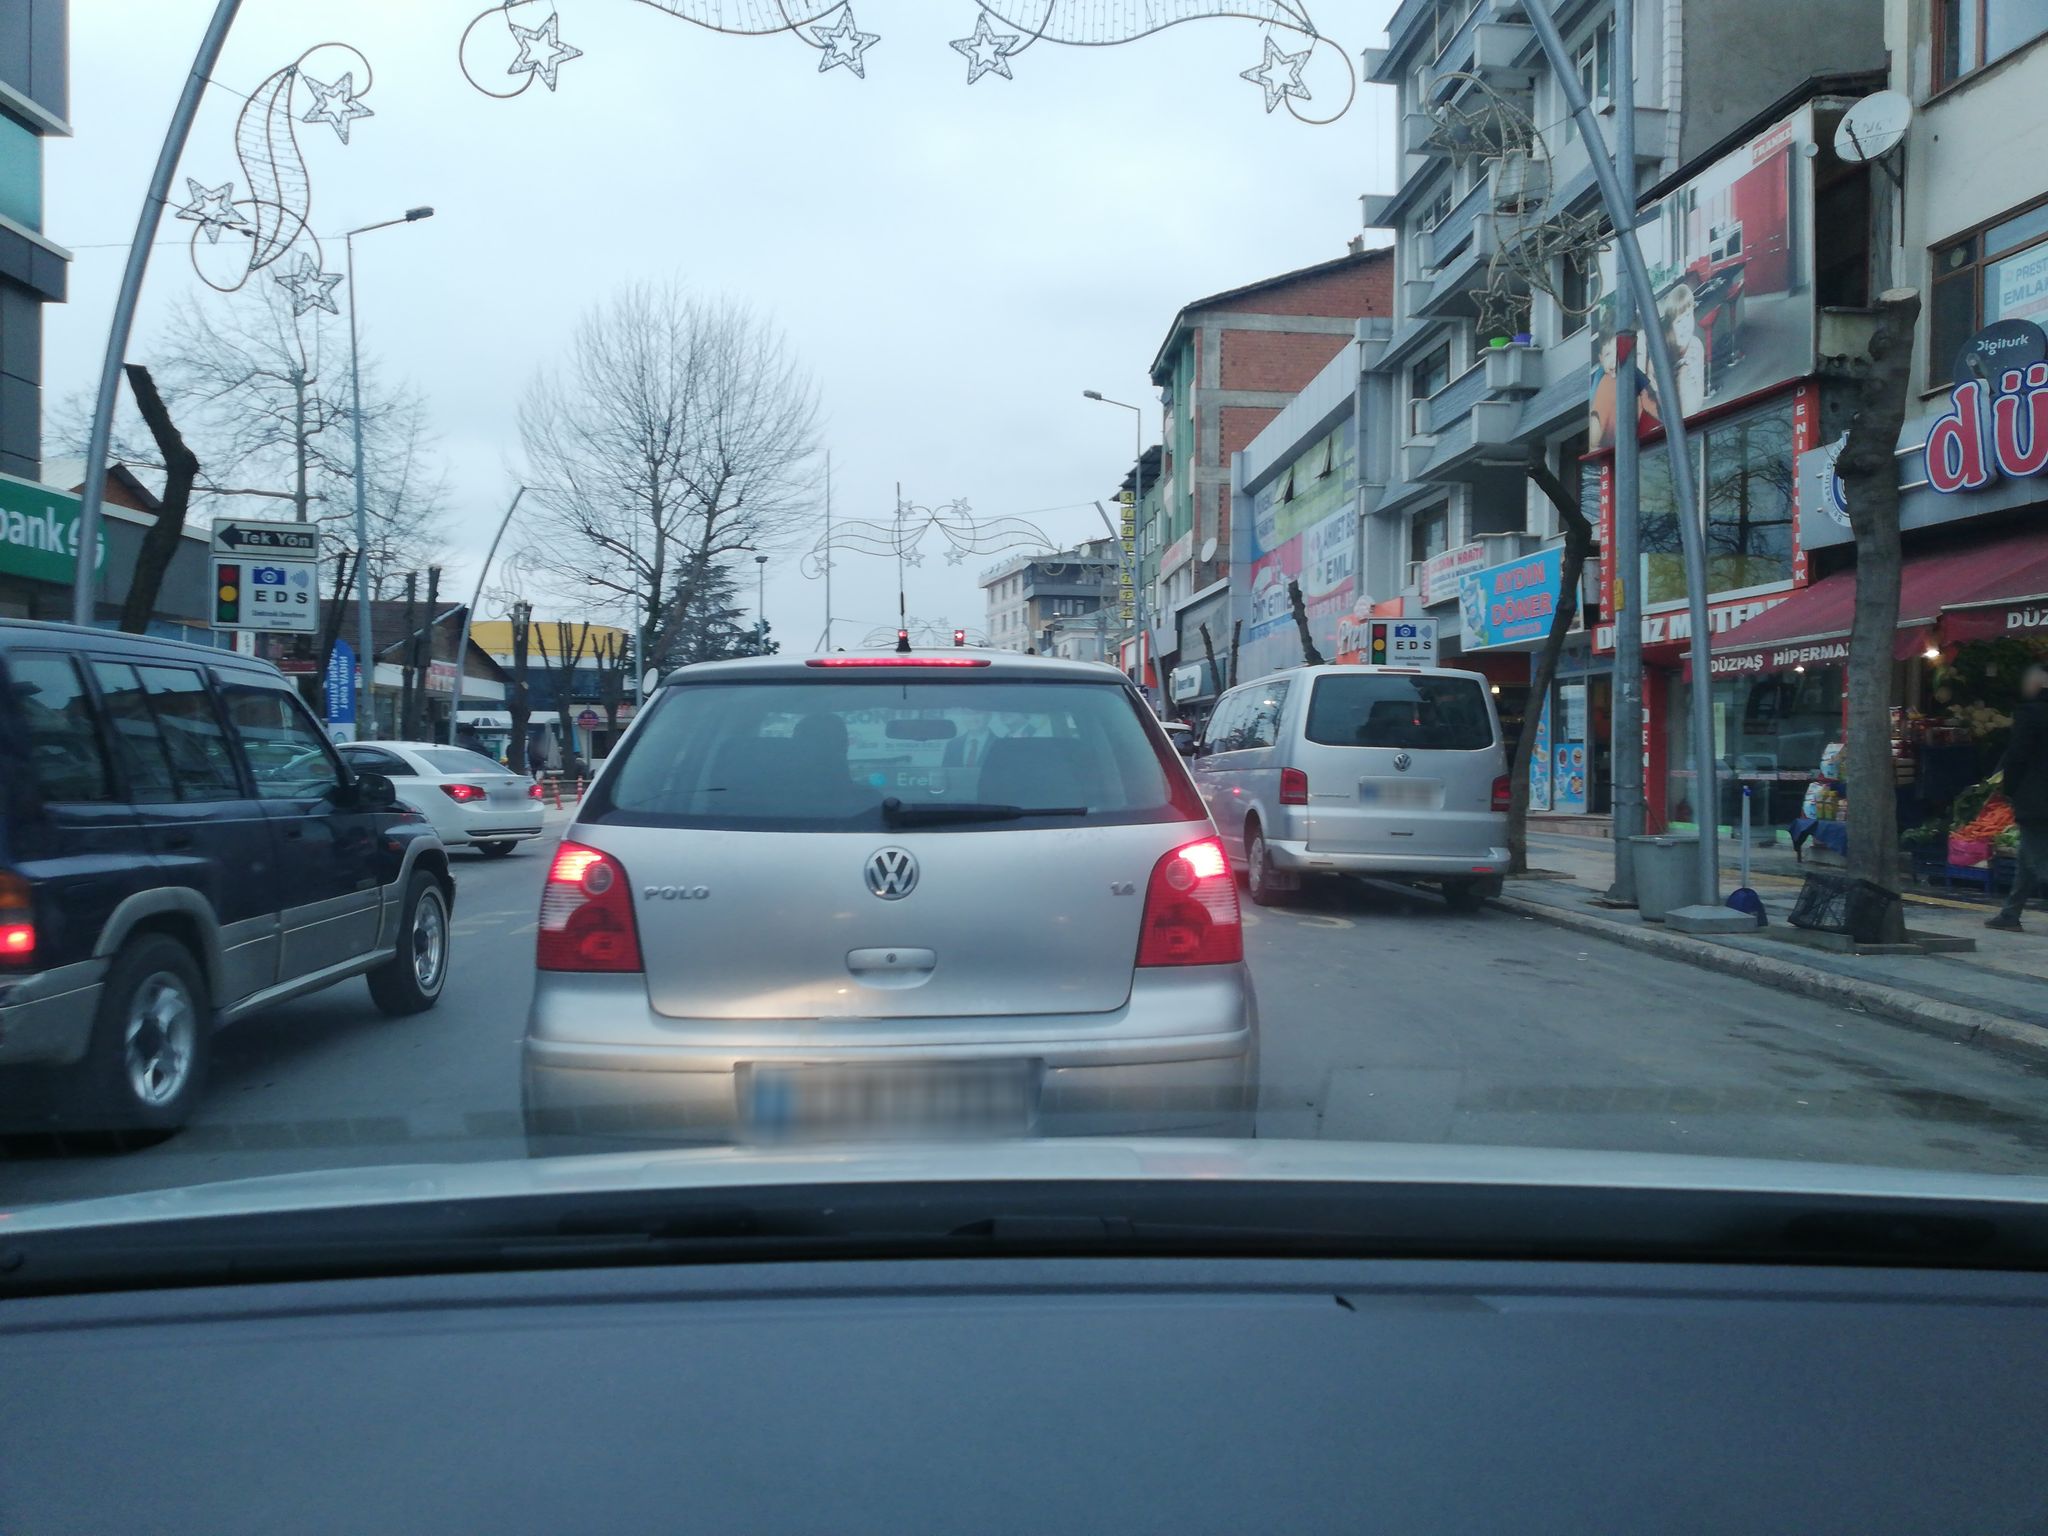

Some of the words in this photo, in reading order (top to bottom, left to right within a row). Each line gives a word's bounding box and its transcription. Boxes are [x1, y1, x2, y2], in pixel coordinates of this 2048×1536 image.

[1976, 334, 2030, 356] Digiturk
[240, 530, 272, 545] Tek
[275, 532, 311, 547] Yön
[1494, 560, 1546, 595] AYDIN
[254, 590, 309, 604] EDS
[1491, 592, 1553, 627] DÖNER
[1596, 615, 1665, 650] DİZ
[1668, 597, 1790, 640] MTFA
[1396, 641, 1432, 650] EDS
[1710, 654, 1764, 673] DÜZPAŞ
[644, 886, 710, 901] POLO
